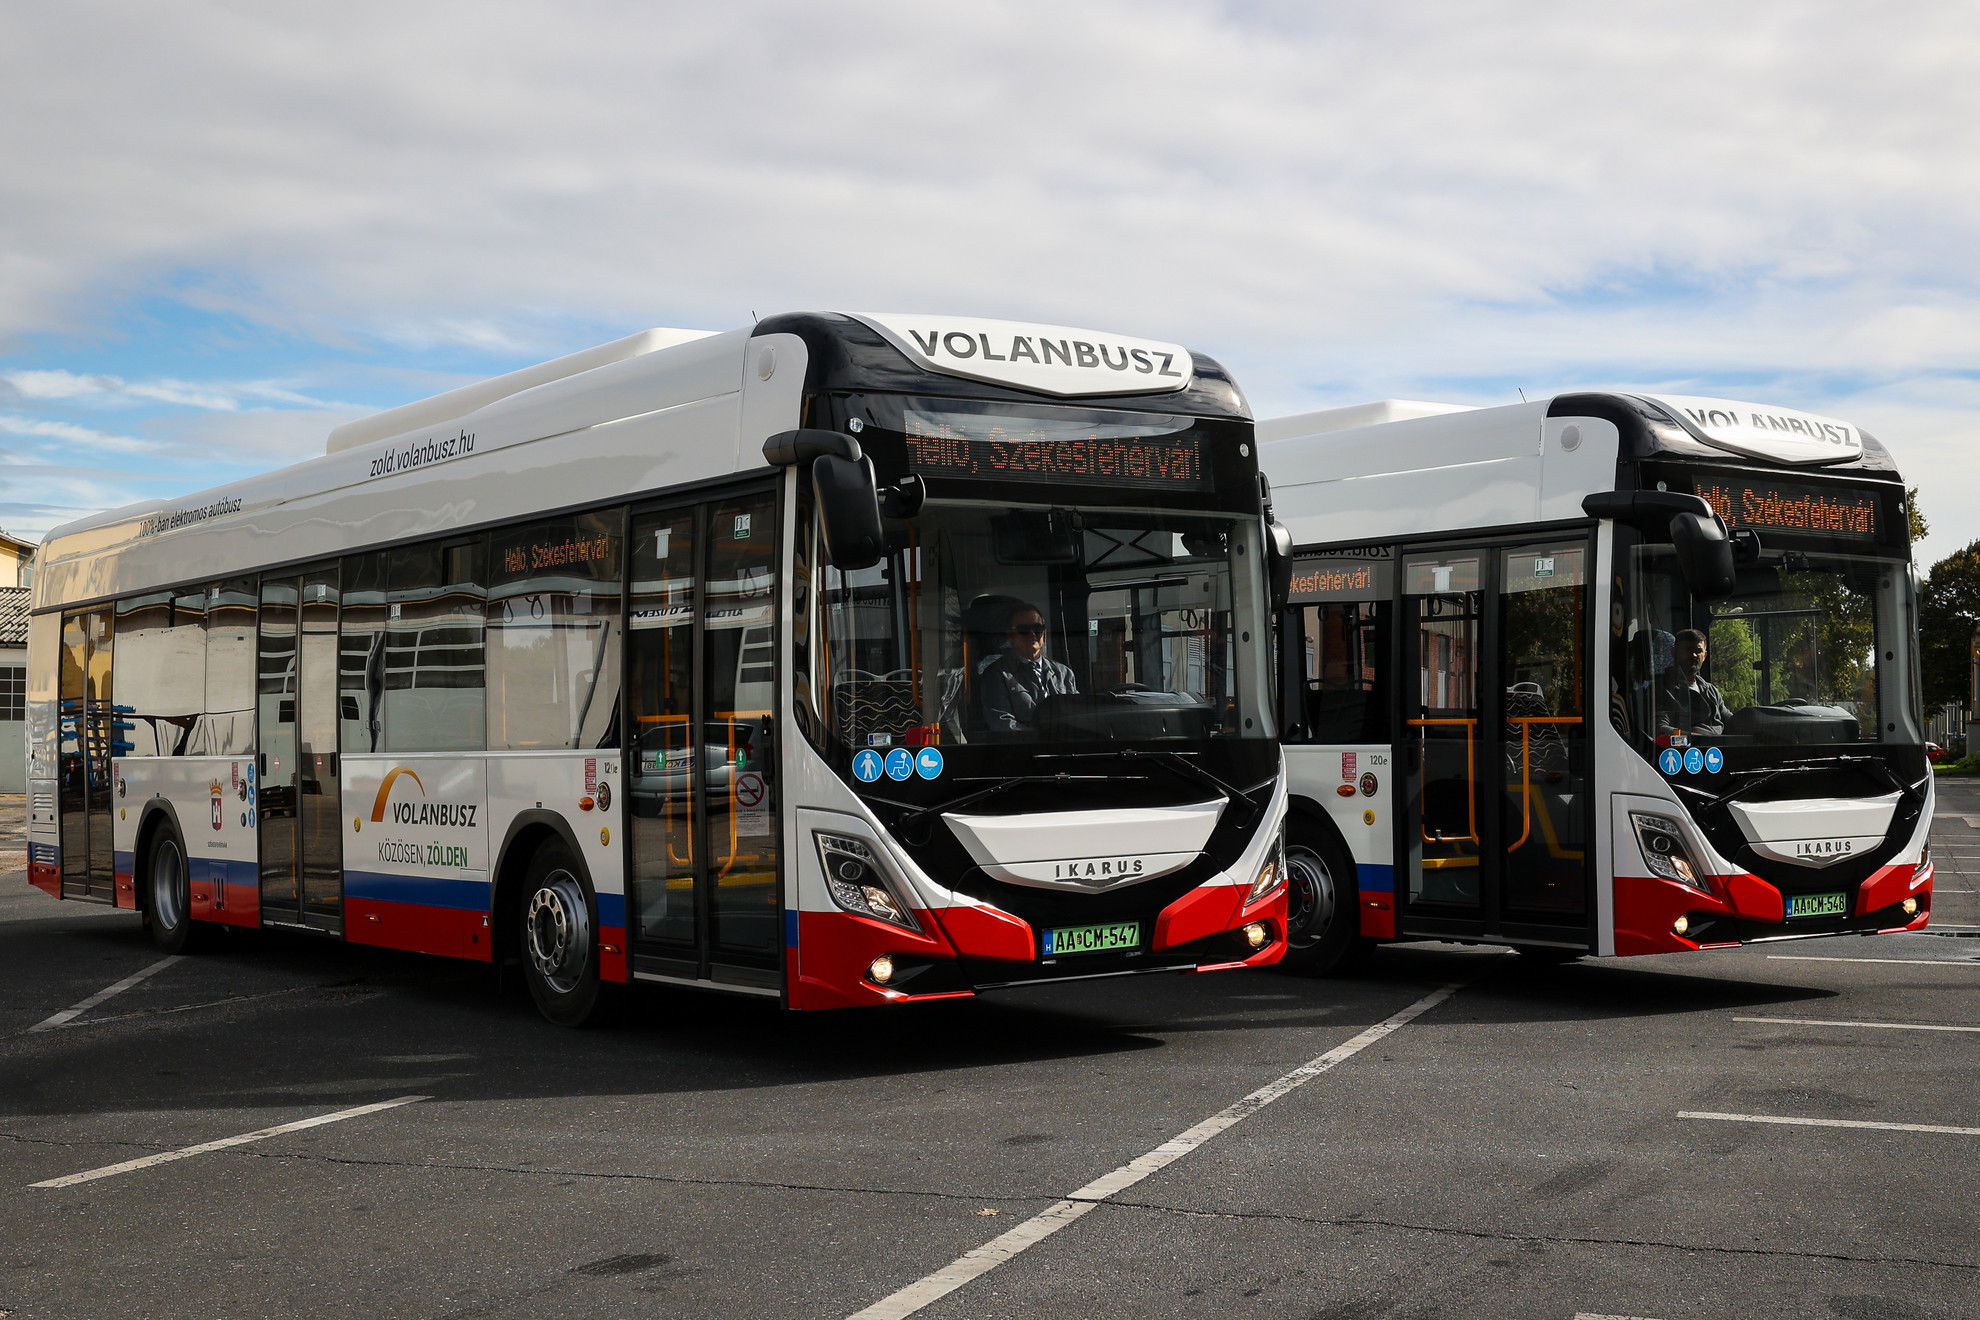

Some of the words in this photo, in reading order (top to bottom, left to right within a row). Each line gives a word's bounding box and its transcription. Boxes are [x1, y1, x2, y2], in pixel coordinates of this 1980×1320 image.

[908, 329, 1183, 378] VOLÁNBUSZ
[370, 429, 475, 477] zold.volanbusz.hu
[170, 507, 208, 529] elektromos
[208, 496, 242, 518] autóbusz
[1742, 488, 1875, 534] Székesfehérvár!
[504, 545, 529, 573] Helló,
[532, 532, 610, 569] Székesfehérvár!
[1370, 754, 1388, 766] 120e
[393, 802, 477, 828] VOLÁNBUSZ
[378, 837, 427, 868] KÖZÖSEN,
[427, 840, 468, 868] ZÖLDEN
[1797, 841, 1851, 854] IKARUS
[1056, 860, 1142, 877] IKARUS
